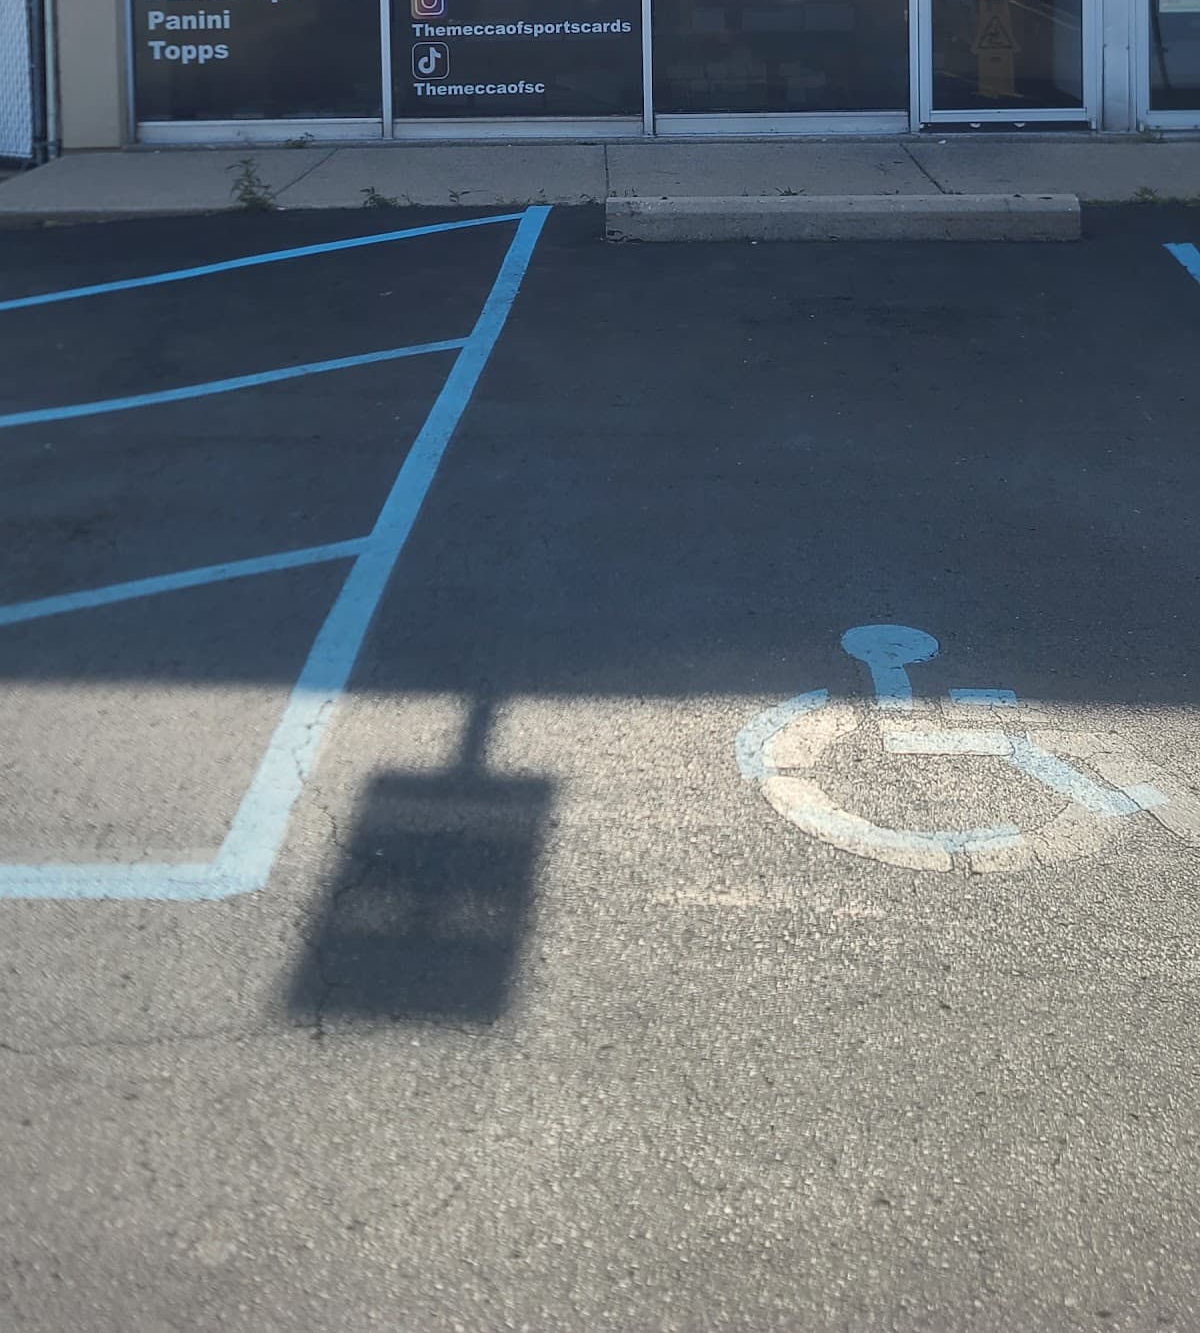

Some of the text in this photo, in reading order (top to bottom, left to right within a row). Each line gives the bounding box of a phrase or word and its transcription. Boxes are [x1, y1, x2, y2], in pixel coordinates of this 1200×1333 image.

[148, 9, 230, 30] Panini
[412, 19, 631, 37] Themeccaofsportscards
[148, 41, 229, 60] Topps
[414, 81, 544, 96] Themeccaofsc
